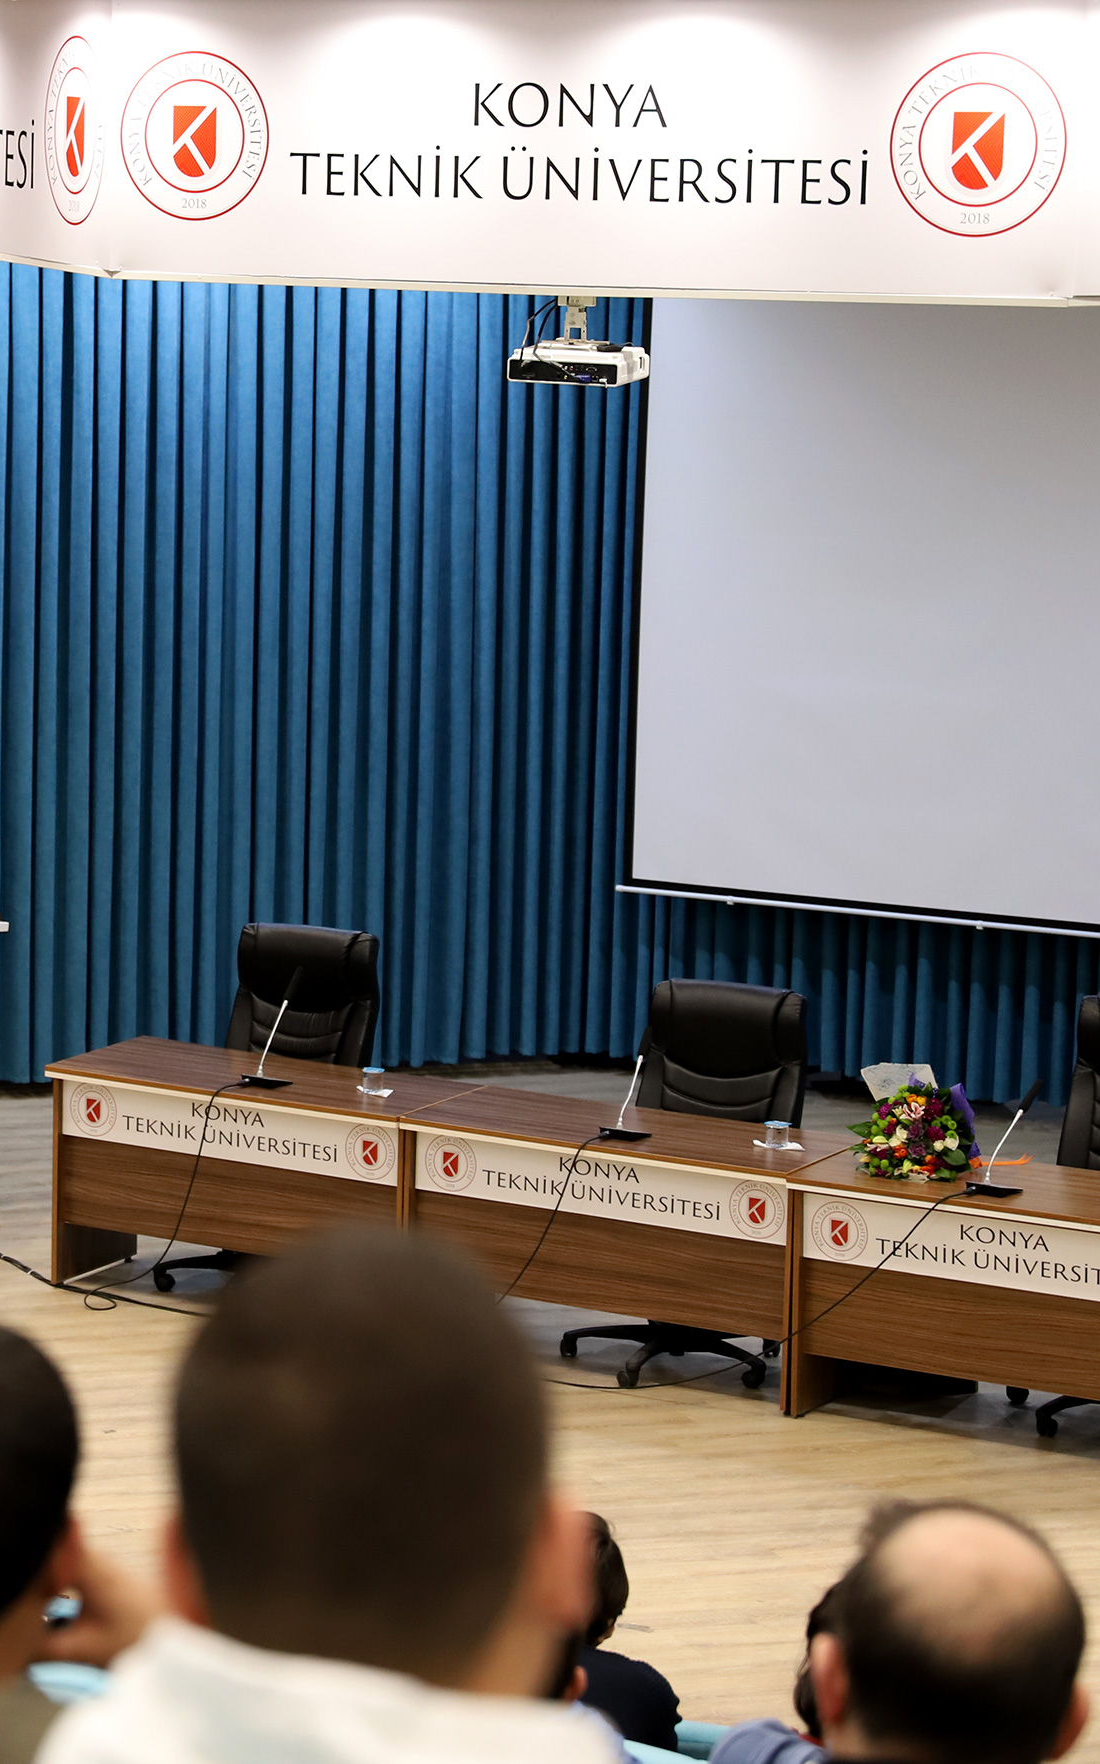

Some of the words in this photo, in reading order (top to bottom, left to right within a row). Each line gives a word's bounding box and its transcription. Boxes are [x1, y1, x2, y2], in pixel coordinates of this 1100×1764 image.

[202, 61, 264, 180] ÜNİVERSİTESİ
[473, 82, 667, 128] KONYA
[289, 145, 483, 199] TEKNİK
[502, 147, 868, 205] ÜNİVERSİTESİ
[899, 125, 926, 200] KONYA
[181, 197, 207, 209] 2018
[959, 212, 990, 225] 2018
[191, 1102, 265, 1128] KONYA
[122, 1115, 196, 1141] TEKNİK
[203, 1125, 338, 1163] ÜNİVERSİTESİ
[559, 1156, 640, 1184] KONYA
[483, 1169, 563, 1196] TEKNİK
[572, 1181, 720, 1221] ÜNİVERSİTESİ
[876, 1238, 966, 1267] TEKNİK
[960, 1224, 1049, 1252] KONYA
